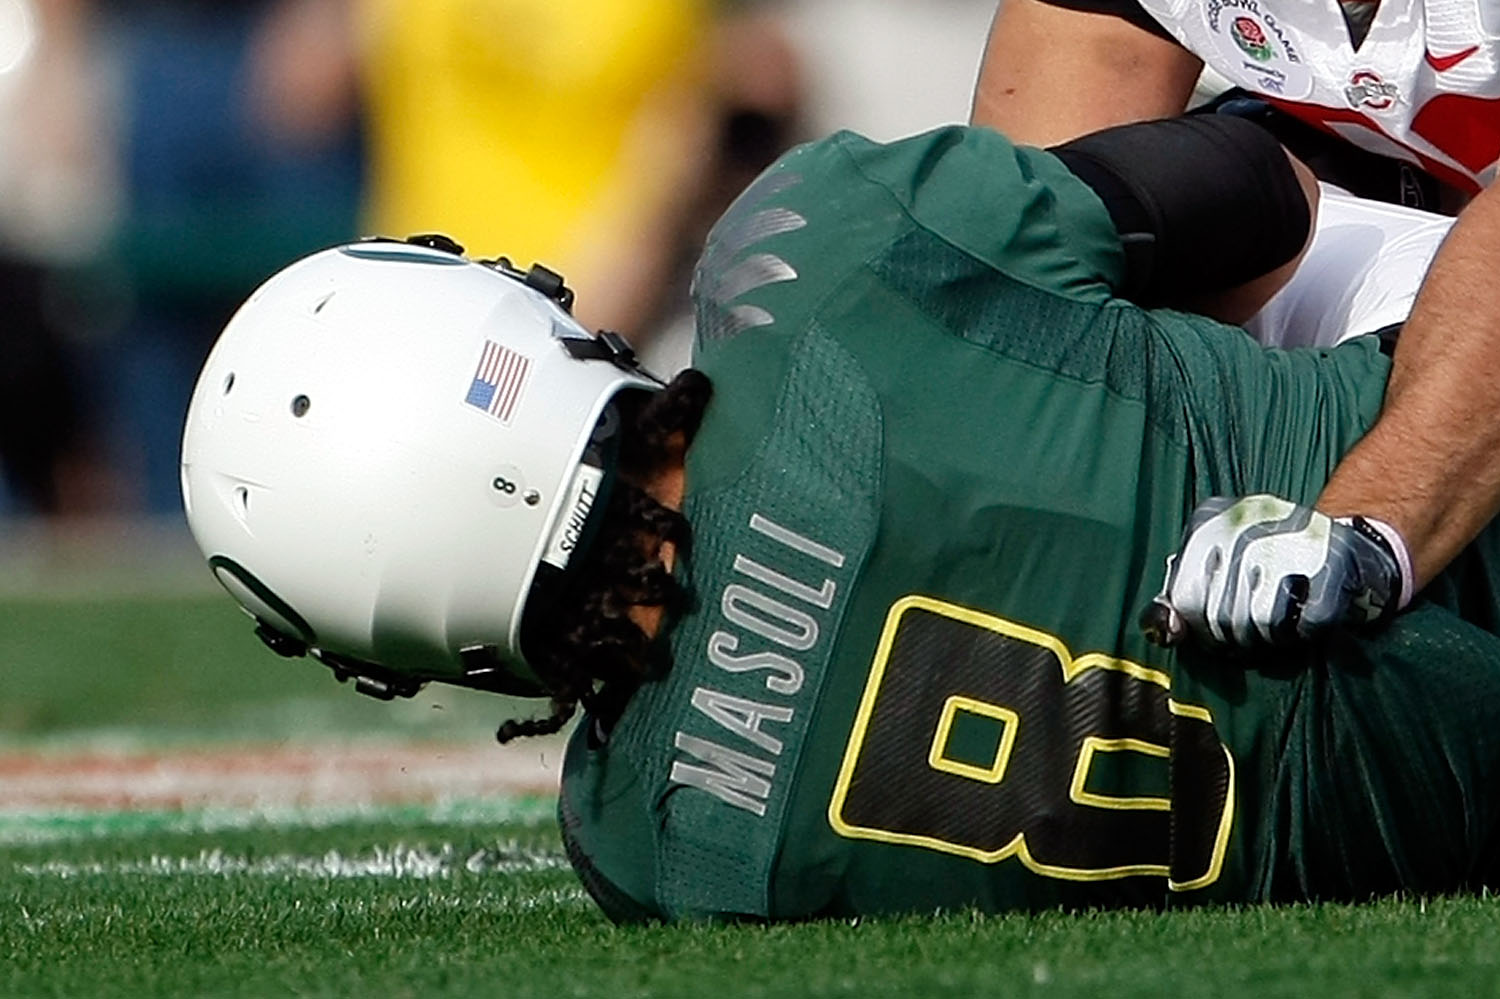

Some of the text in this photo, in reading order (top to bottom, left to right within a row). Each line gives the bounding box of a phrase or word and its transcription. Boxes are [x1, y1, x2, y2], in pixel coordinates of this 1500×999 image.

[493, 477, 516, 495] 8
[560, 484, 595, 552] SCHUTT
[670, 512, 845, 816] MASOLI
[828, 594, 1236, 891] 8
